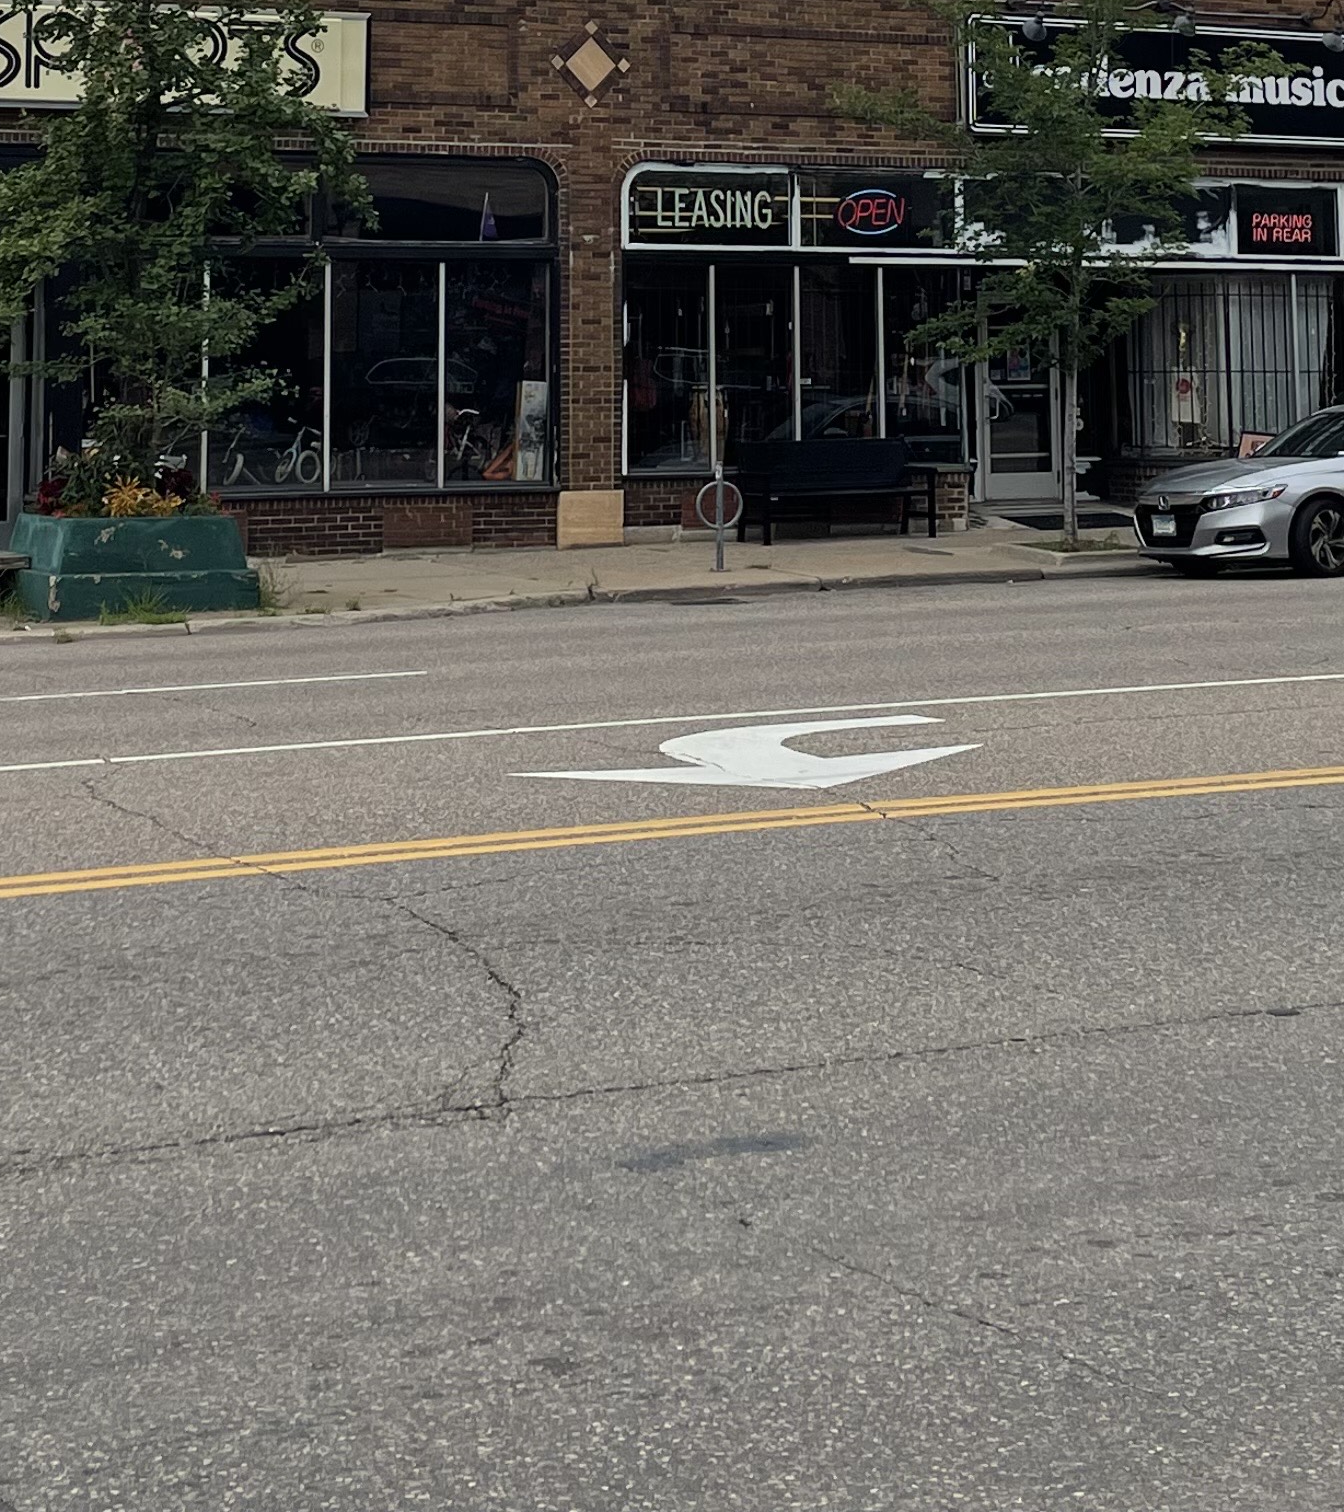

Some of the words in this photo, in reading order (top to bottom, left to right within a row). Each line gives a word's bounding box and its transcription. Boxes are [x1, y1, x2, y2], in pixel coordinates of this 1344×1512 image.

[656, 187, 773, 229] LEASING
[837, 197, 905, 227] OPEN
[1252, 213, 1313, 228] PARKING
[1253, 228, 1267, 242] IN
[1273, 228, 1312, 242] REAR
